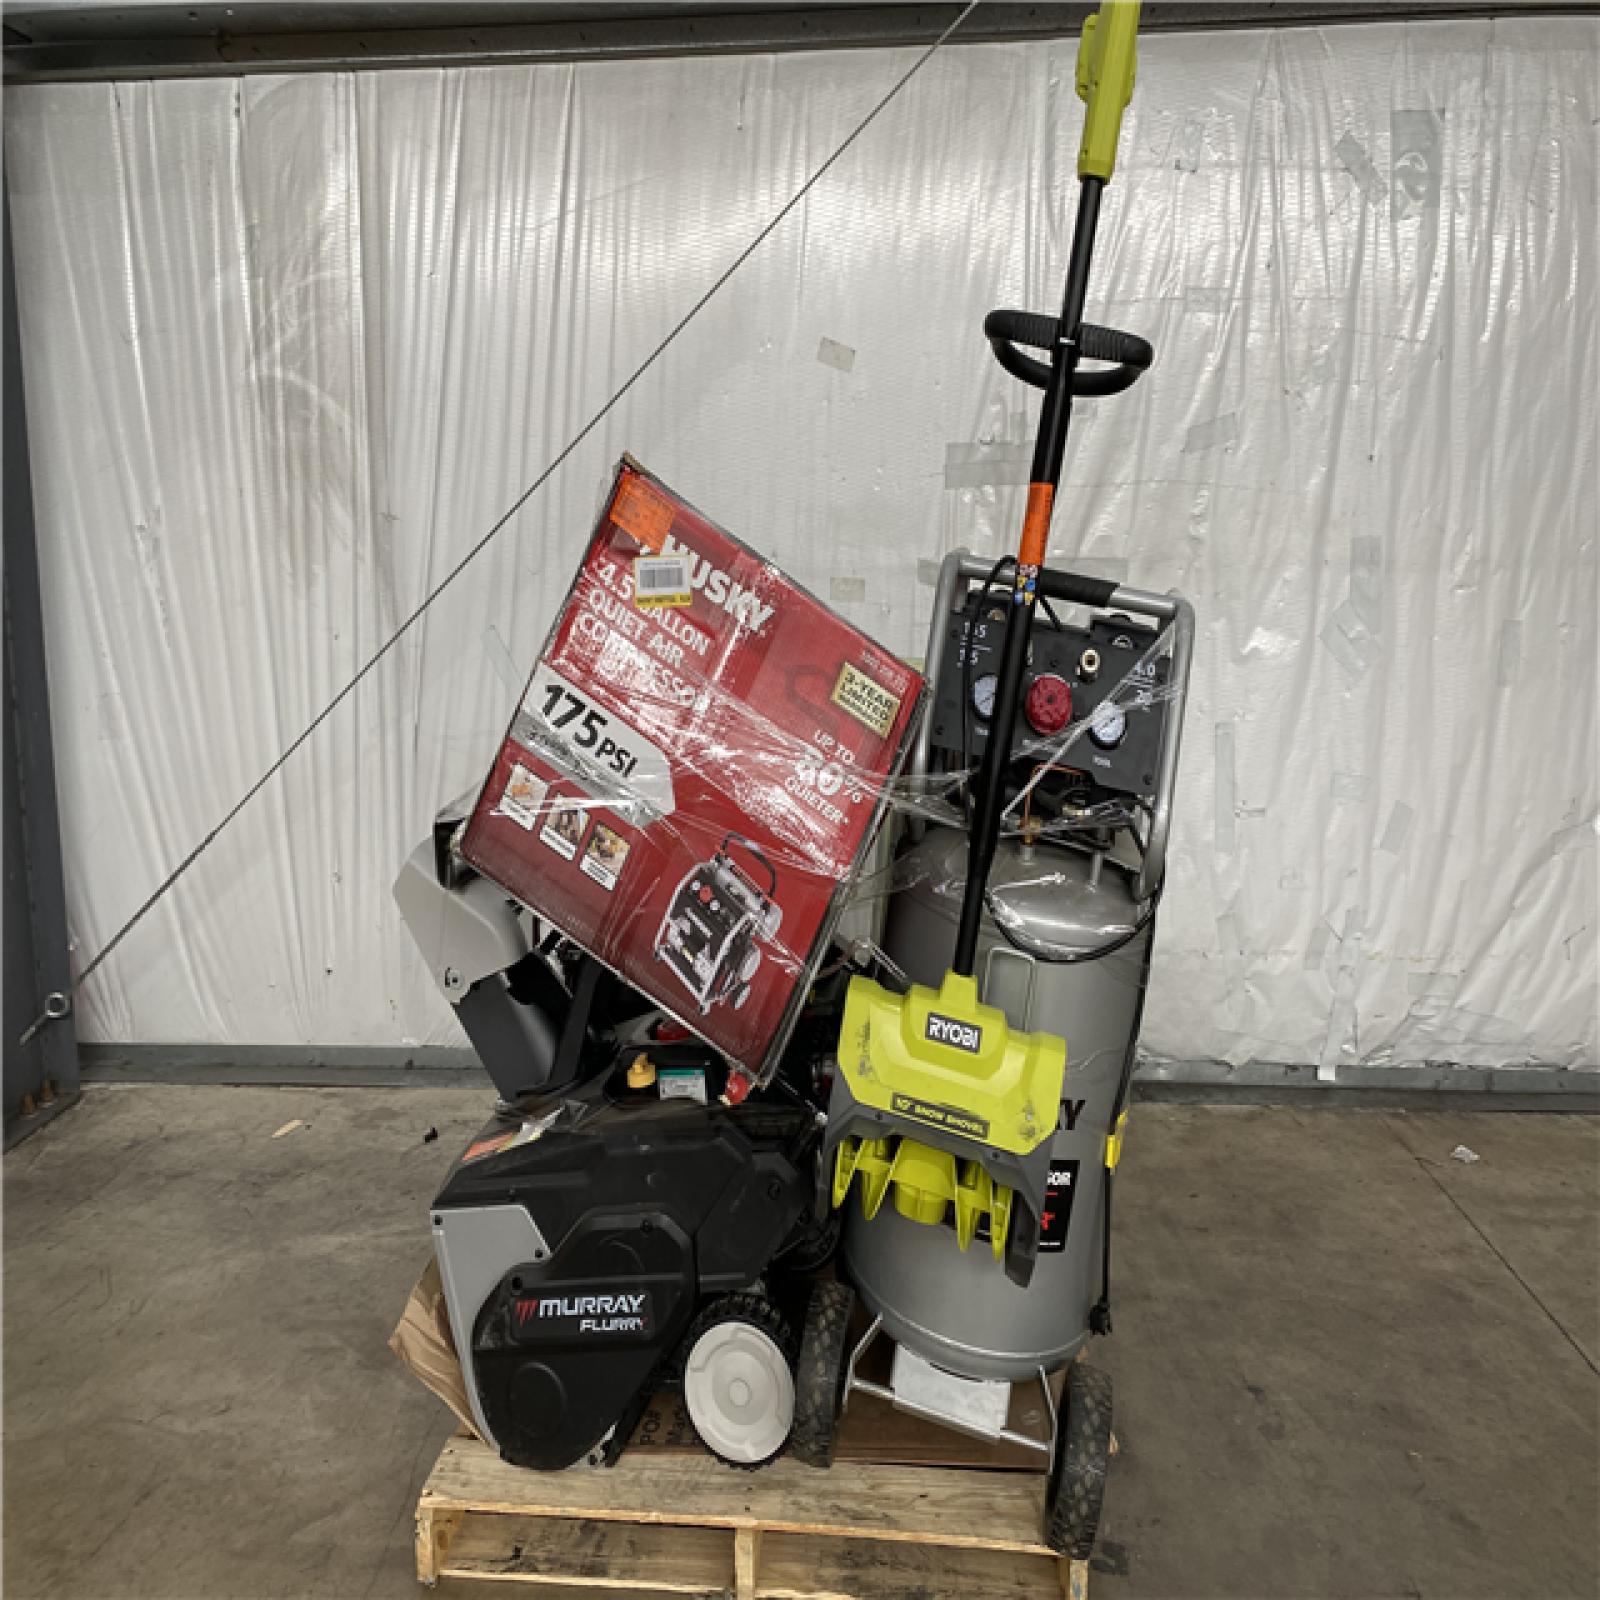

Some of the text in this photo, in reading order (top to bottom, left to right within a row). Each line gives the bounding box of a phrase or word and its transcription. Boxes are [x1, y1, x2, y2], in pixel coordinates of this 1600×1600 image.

[589, 588, 684, 668] QUIET AIR
[640, 606, 711, 656] ALLON
[542, 684, 608, 748] 175
[594, 737, 638, 778] PSI
[834, 742, 856, 767] TO
[929, 1016, 979, 1049] RYOBI
[539, 1294, 646, 1319] MURRAY
